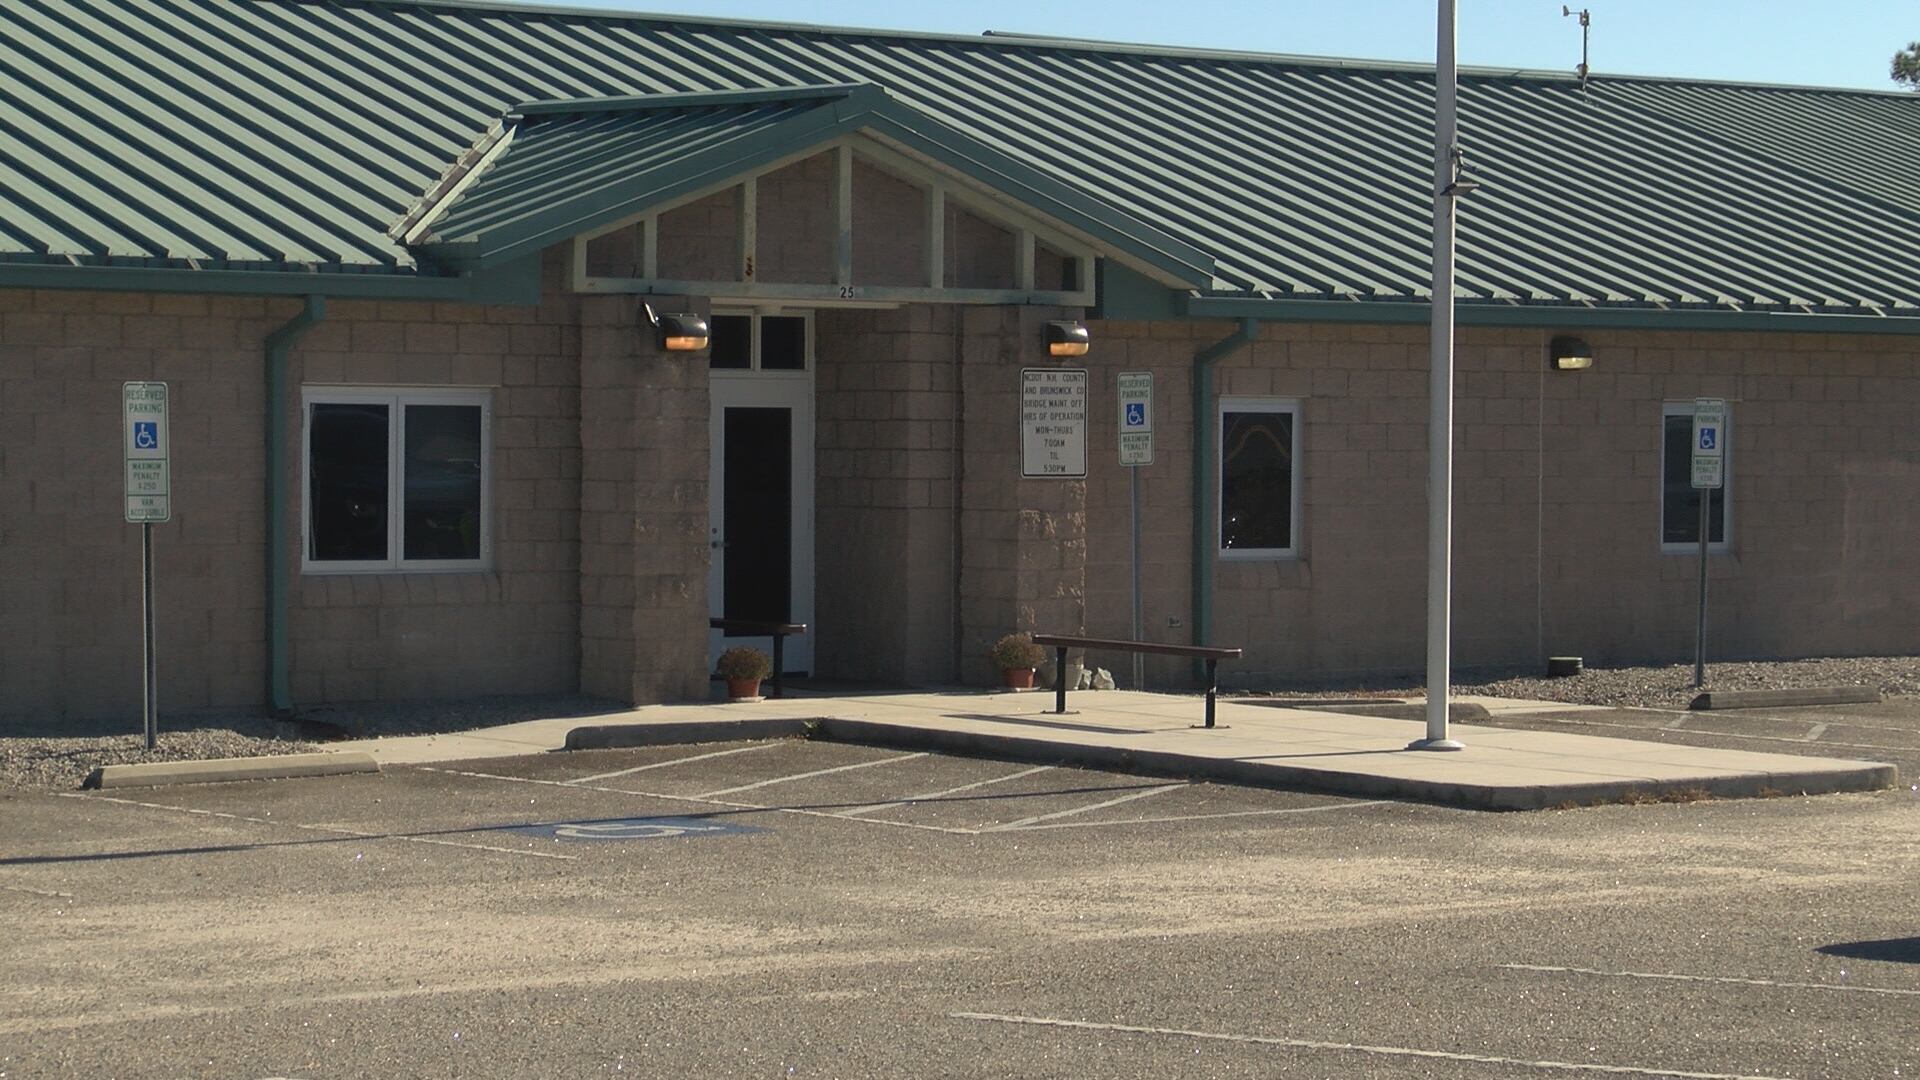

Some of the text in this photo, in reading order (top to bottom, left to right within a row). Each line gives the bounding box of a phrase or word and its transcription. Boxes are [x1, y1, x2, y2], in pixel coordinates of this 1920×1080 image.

[840, 286, 854, 299] 25
[1024, 373, 1042, 382] NCDOT
[1062, 373, 1084, 382] COUNTY
[1024, 386, 1036, 395] AND
[1040, 386, 1072, 395] BRUNSWICK
[1121, 390, 1149, 399] PARKING
[126, 390, 165, 401] RESERVED
[129, 402, 163, 414] PARKING
[1024, 399, 1047, 408] BRIDGE
[1049, 399, 1067, 408] MAINT
[1024, 412, 1084, 421] HRS OF OPERATION
[1035, 425, 1073, 435] MON-THURS
[133, 471, 160, 480] PENALTY
